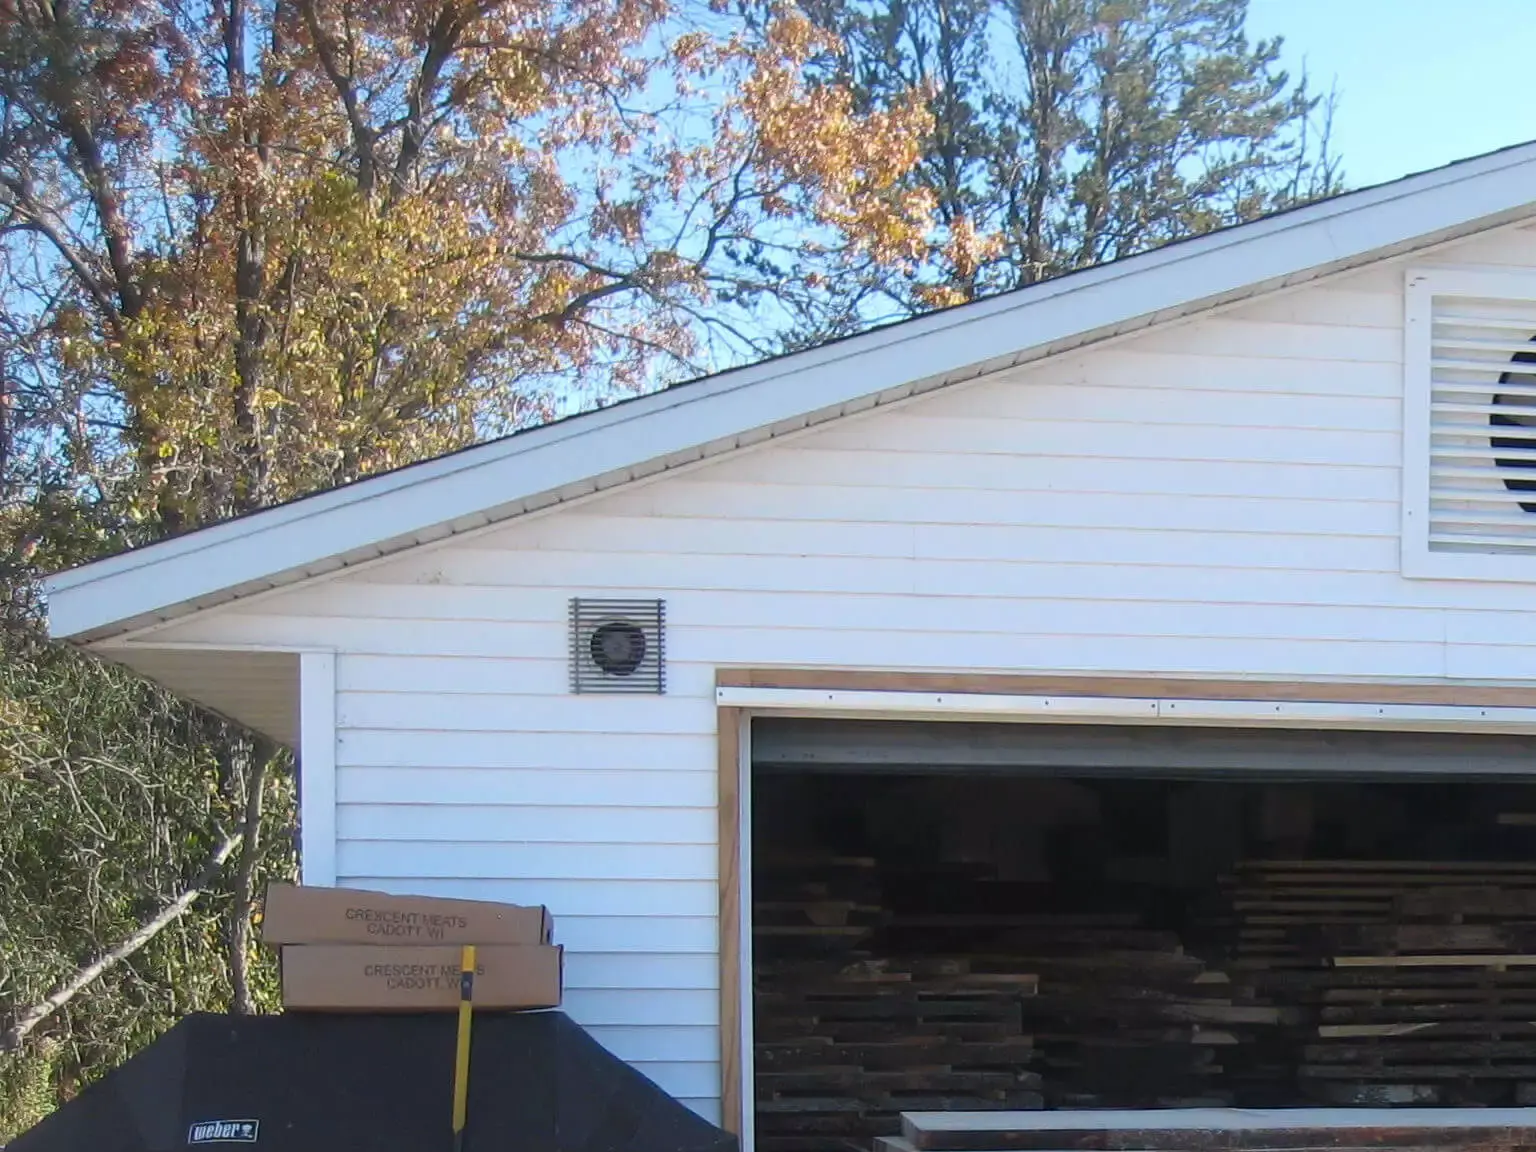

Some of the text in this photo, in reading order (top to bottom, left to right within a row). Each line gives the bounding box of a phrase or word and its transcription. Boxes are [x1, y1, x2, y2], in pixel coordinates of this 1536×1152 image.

[345, 908, 468, 928] CRESCENT MEATS
[427, 926, 444, 939] WI
[364, 964, 485, 976] CRESCENT MES
[193, 1120, 240, 1140] weber
